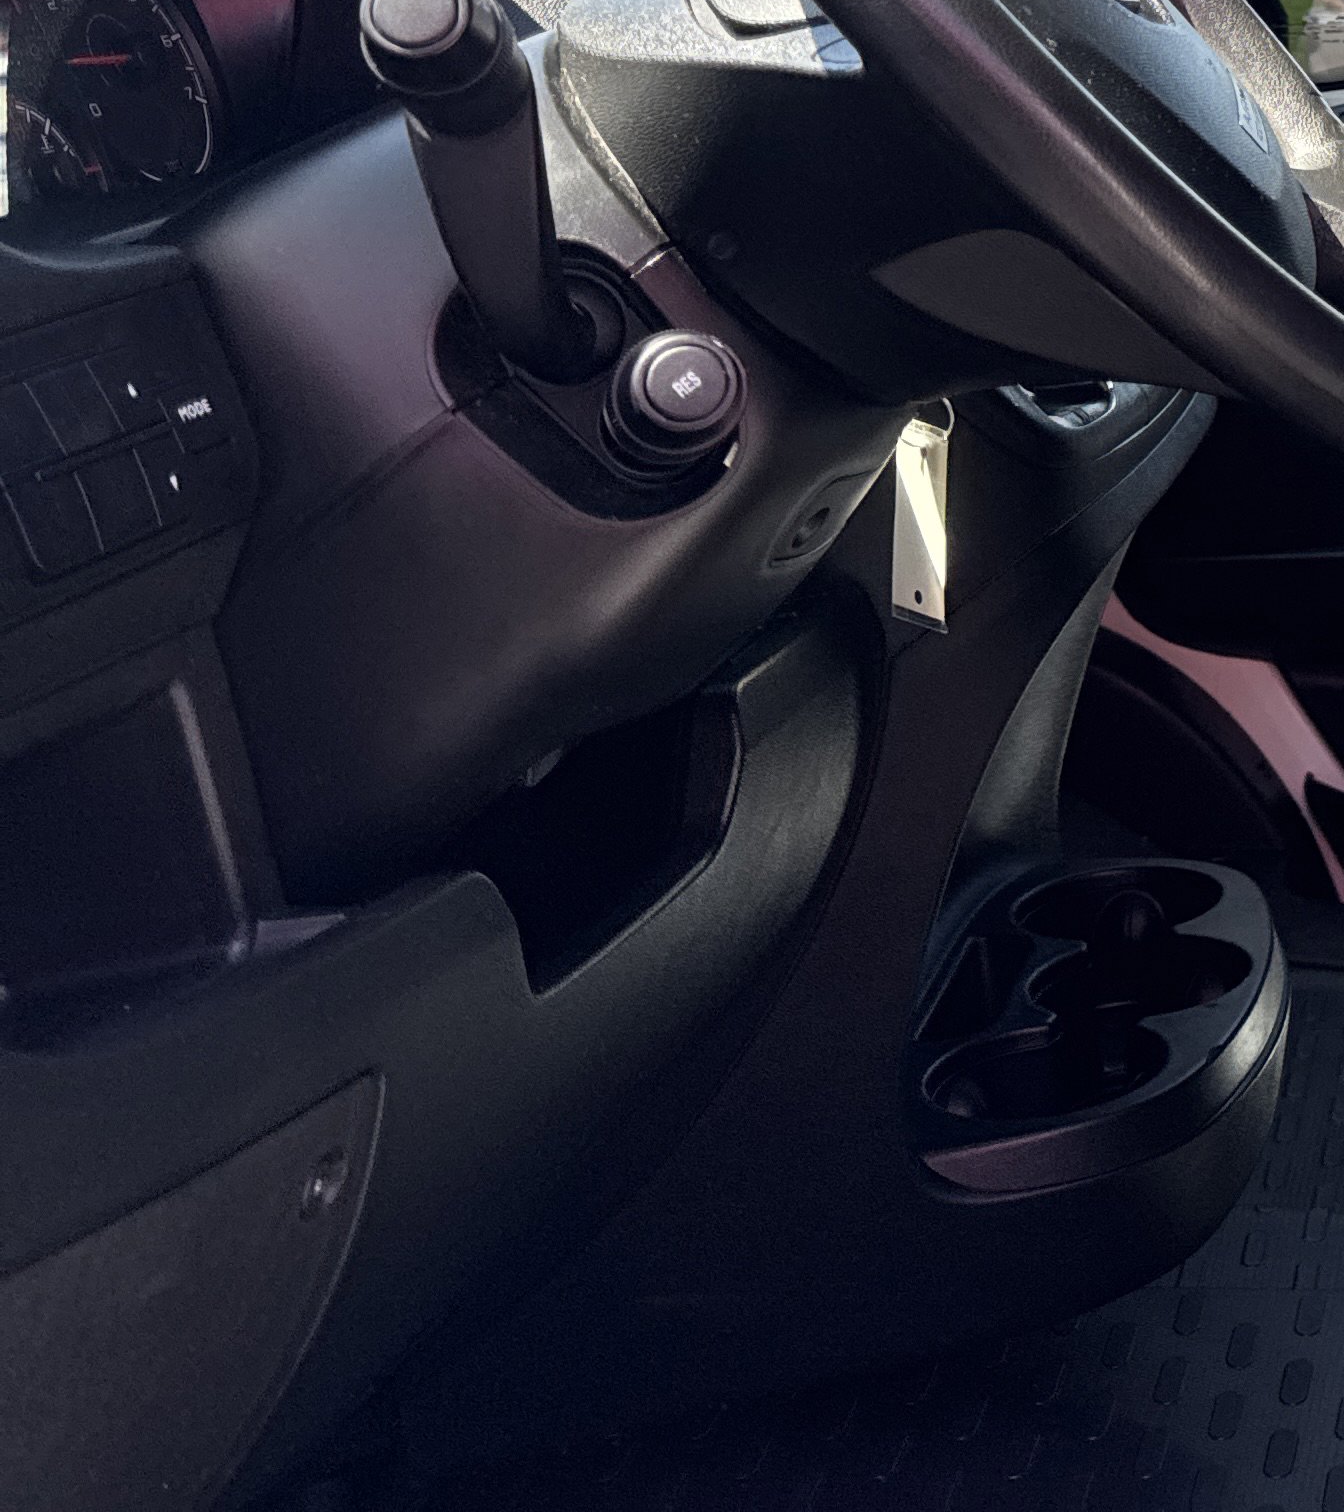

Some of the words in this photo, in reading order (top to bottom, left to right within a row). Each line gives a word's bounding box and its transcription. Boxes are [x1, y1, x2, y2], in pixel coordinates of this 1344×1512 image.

[160, 34, 174, 49] 6
[184, 87, 193, 100] 7
[89, 103, 102, 117] 0
[671, 371, 702, 399] RES
[177, 398, 212, 424] MODE
